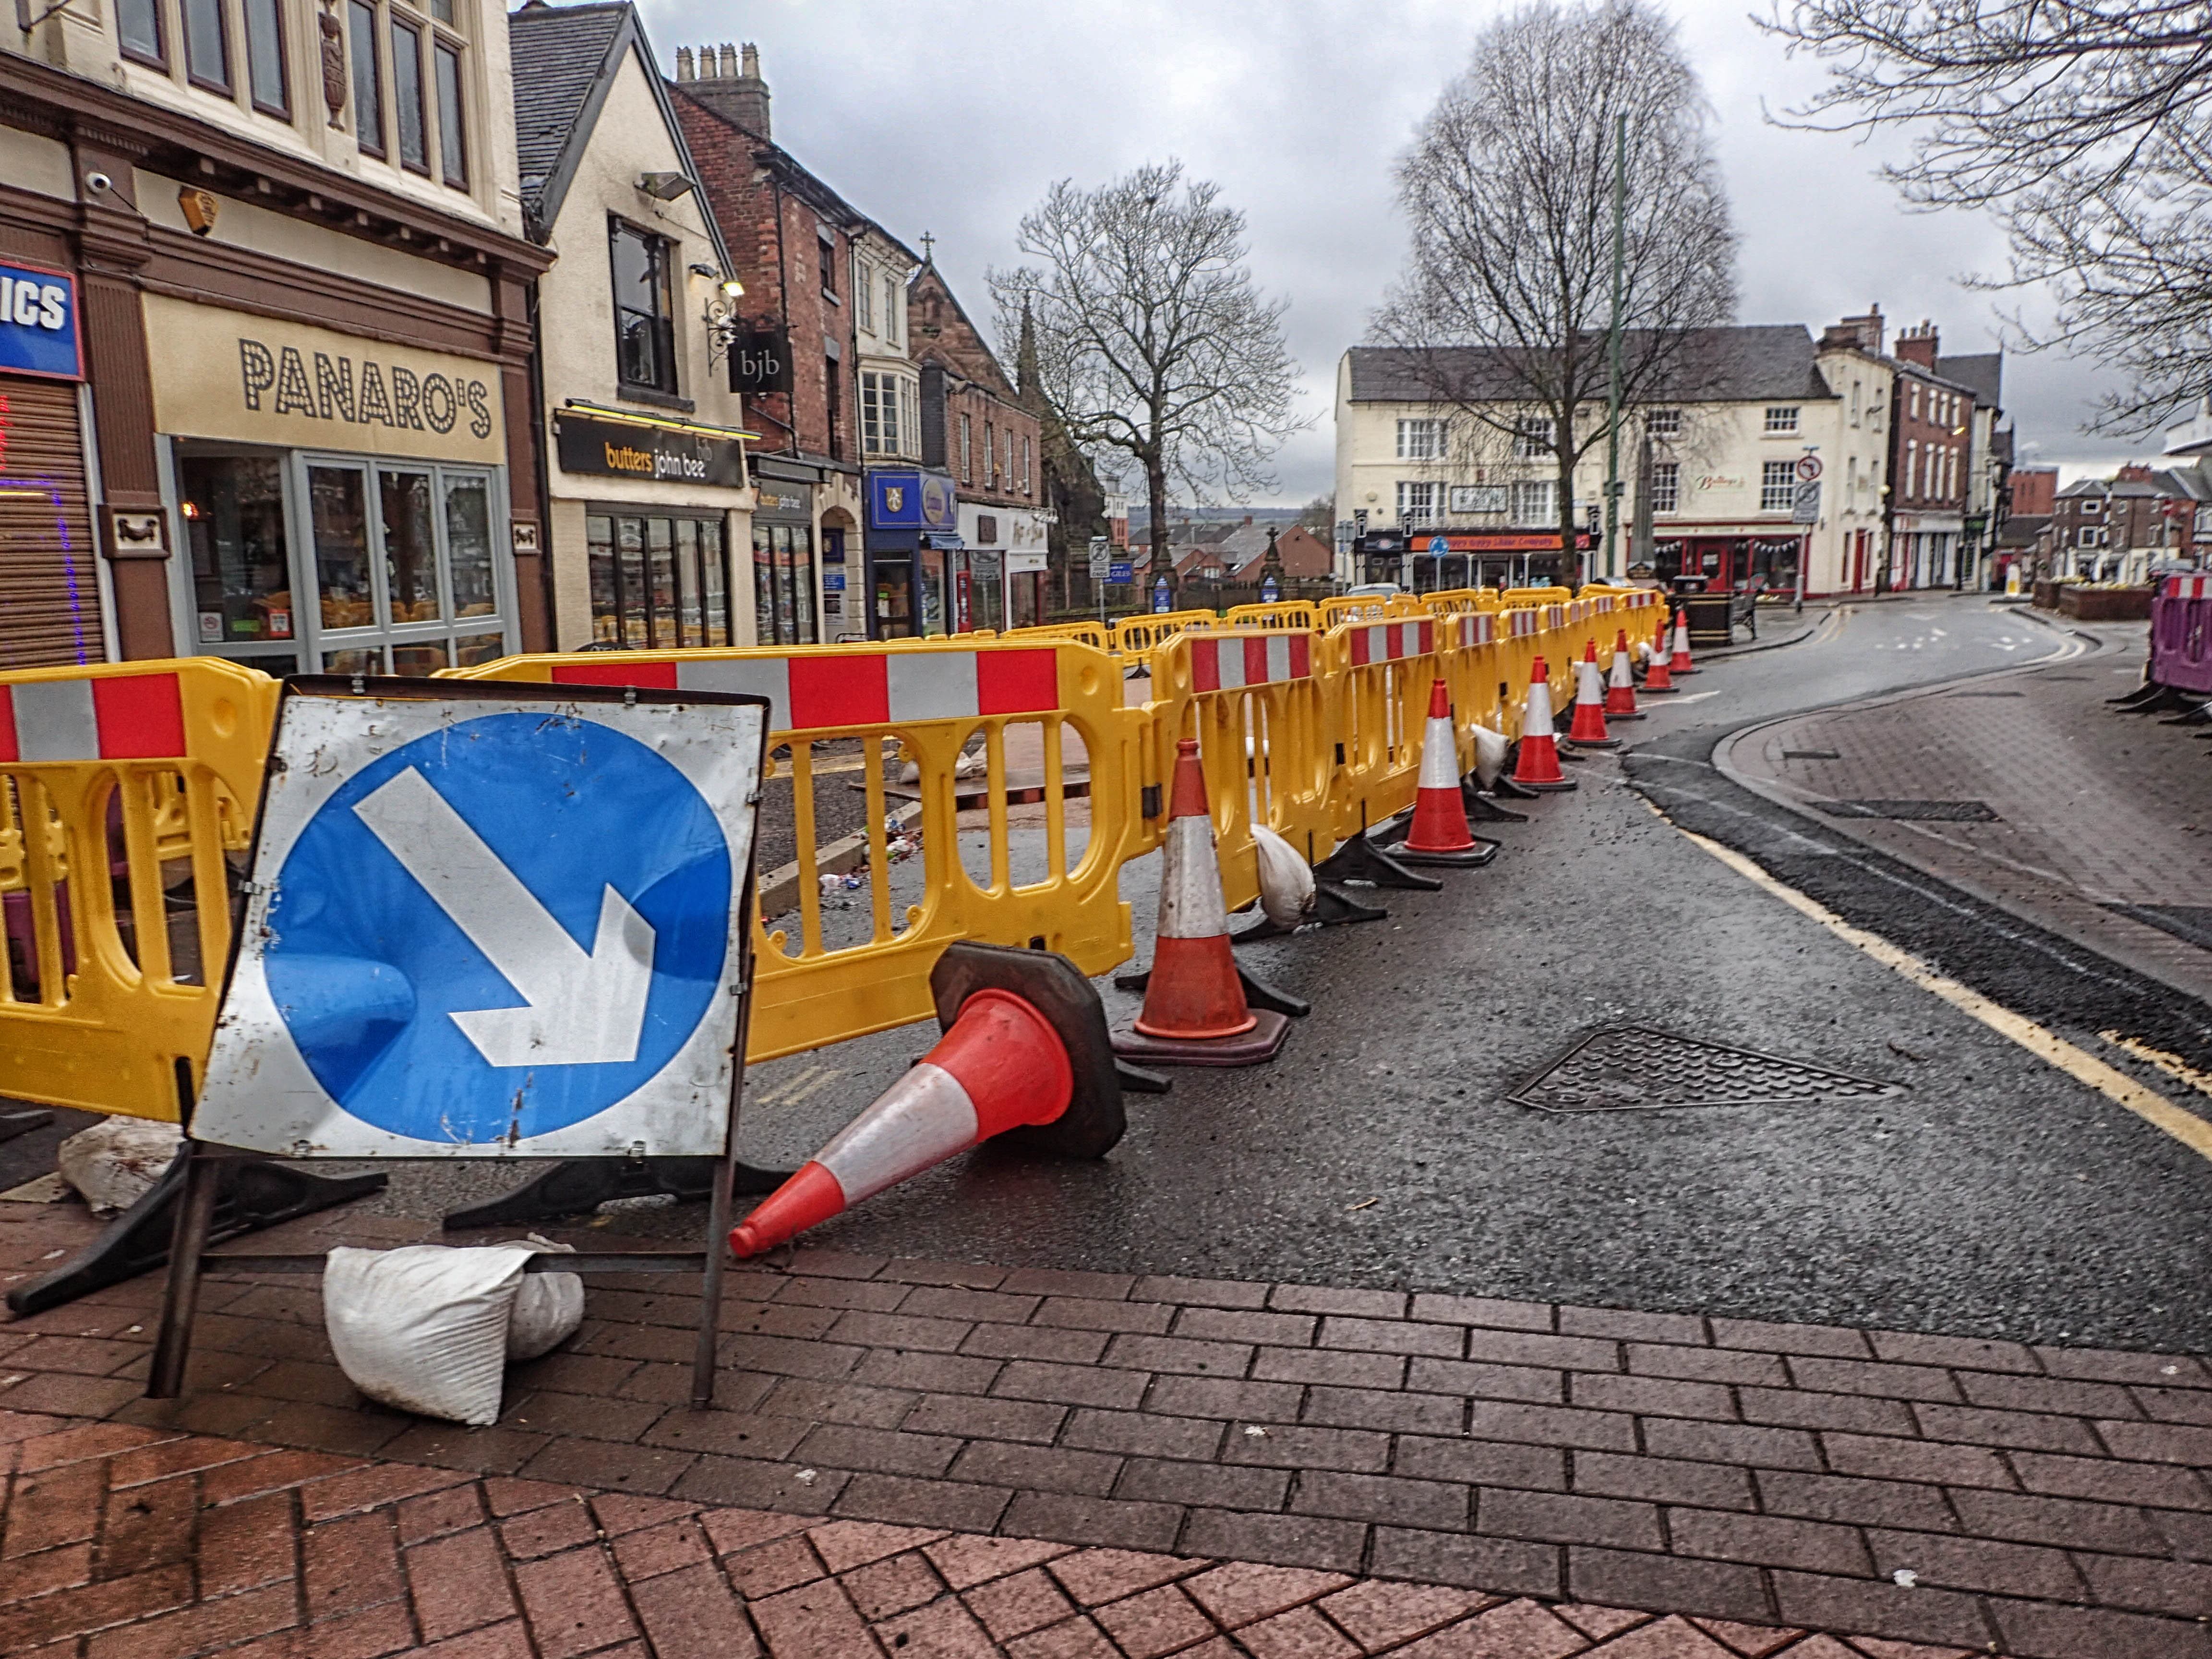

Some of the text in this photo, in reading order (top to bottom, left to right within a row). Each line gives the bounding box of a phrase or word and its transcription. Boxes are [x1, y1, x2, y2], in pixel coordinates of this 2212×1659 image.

[0, 276, 65, 330] ICS
[239, 338, 492, 439] PANARO'S
[740, 349, 780, 383] bjb
[604, 442, 653, 472] butters
[653, 448, 682, 479] john
[682, 453, 706, 478] bee
